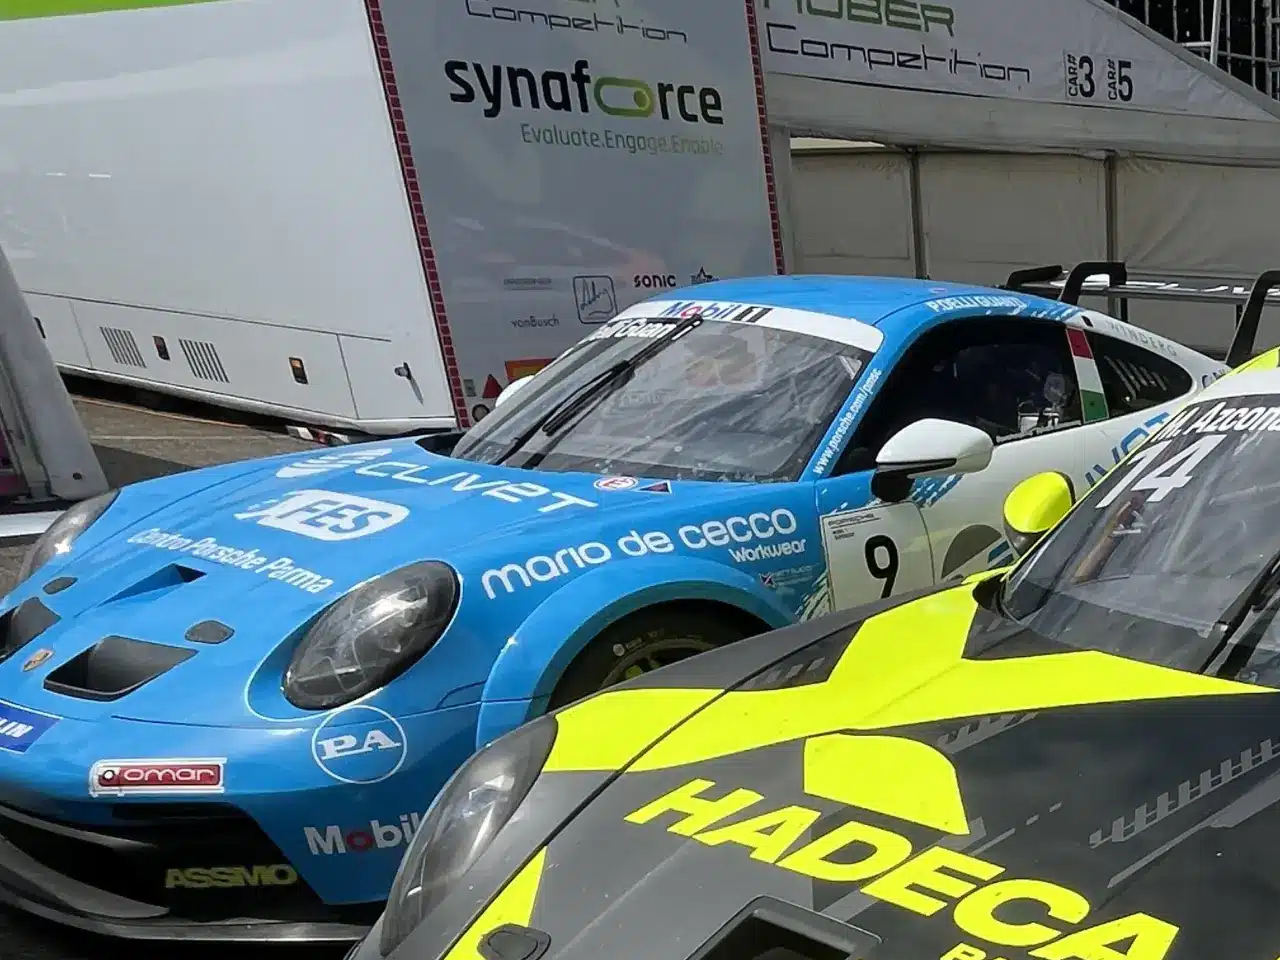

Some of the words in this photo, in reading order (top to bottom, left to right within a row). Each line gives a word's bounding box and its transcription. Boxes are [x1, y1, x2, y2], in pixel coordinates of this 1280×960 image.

[764, 0, 955, 37] UBER
[766, 22, 1030, 83] Competition
[1067, 54, 1078, 97] CAR#
[1079, 55, 1095, 98] 3
[444, 60, 724, 125] synaforce
[1107, 58, 1118, 100] CAR#
[1117, 60, 1133, 102] 5
[354, 460, 598, 513] CLIVET
[1094, 434, 1229, 508] 14
[180, 537, 268, 569] Porsche
[255, 557, 334, 593] Parma
[481, 542, 612, 600] mario
[617, 530, 675, 557] de
[678, 508, 798, 550] cecco
[728, 538, 807, 563] Workwear
[864, 534, 899, 599] 9
[317, 729, 402, 760] PA
[165, 864, 299, 889] ASSMO
